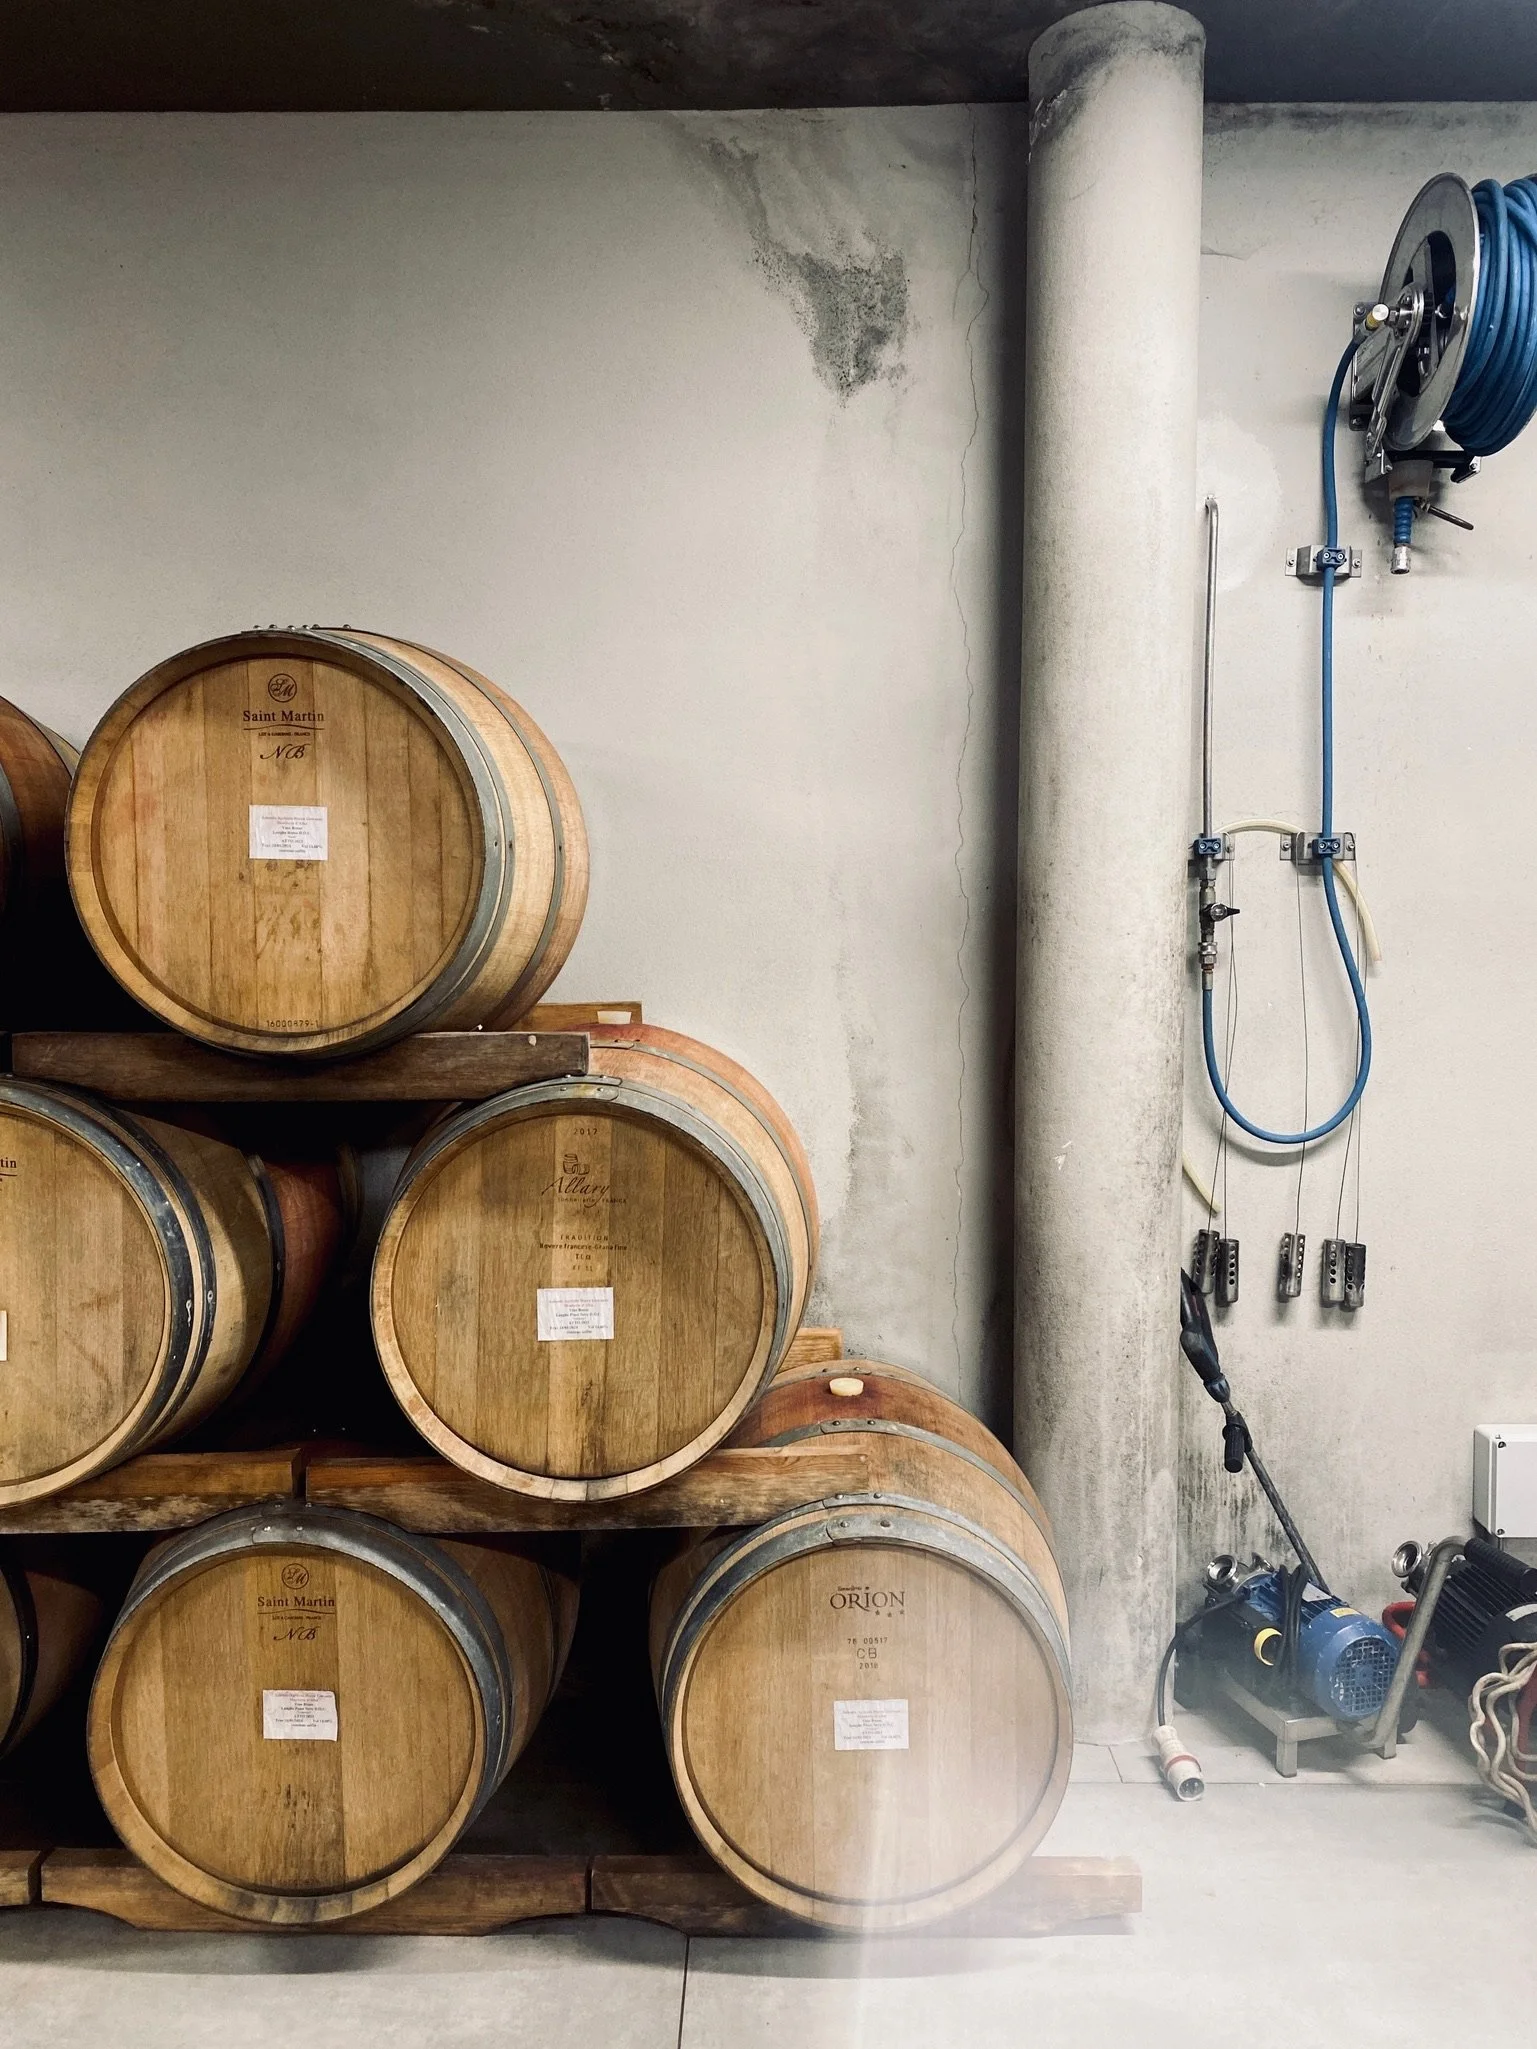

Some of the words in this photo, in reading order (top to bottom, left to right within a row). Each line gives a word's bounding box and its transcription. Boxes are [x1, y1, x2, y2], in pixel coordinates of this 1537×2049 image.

[243, 710, 276, 722] Saint
[281, 710, 324, 722] Martin
[574, 1127, 598, 1136] 2017
[257, 1596, 289, 1607] Saint
[294, 1595, 335, 1607] Martin
[857, 1648, 877, 1659] CB
